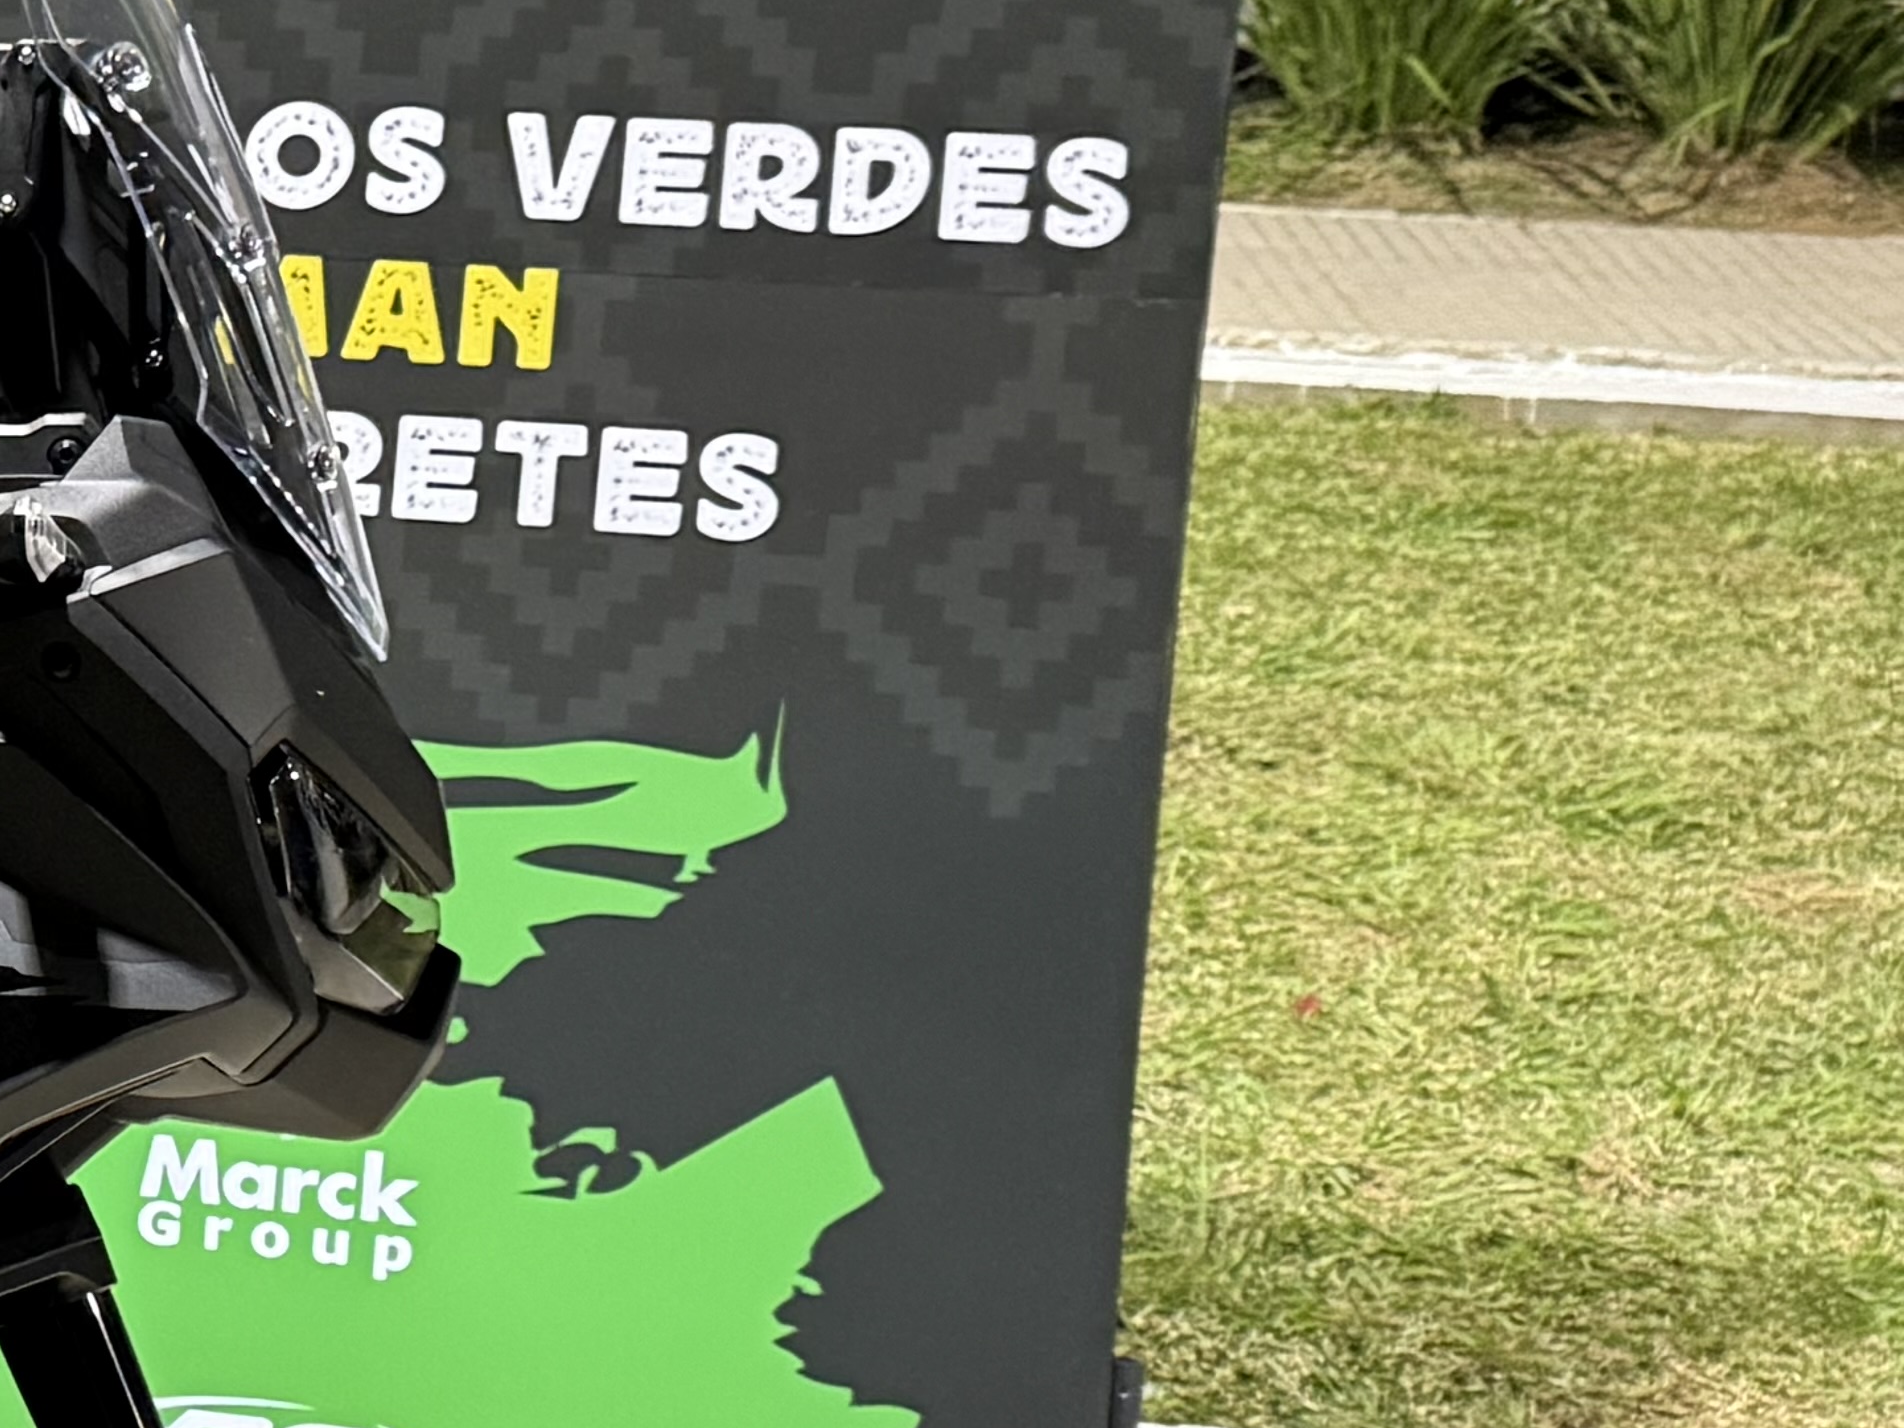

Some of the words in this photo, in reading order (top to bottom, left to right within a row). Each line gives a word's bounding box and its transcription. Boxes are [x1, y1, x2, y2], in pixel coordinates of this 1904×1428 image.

[506, 112, 1131, 249] VERDES
[139, 1134, 421, 1227] Marck
[137, 1200, 414, 1281] Group
